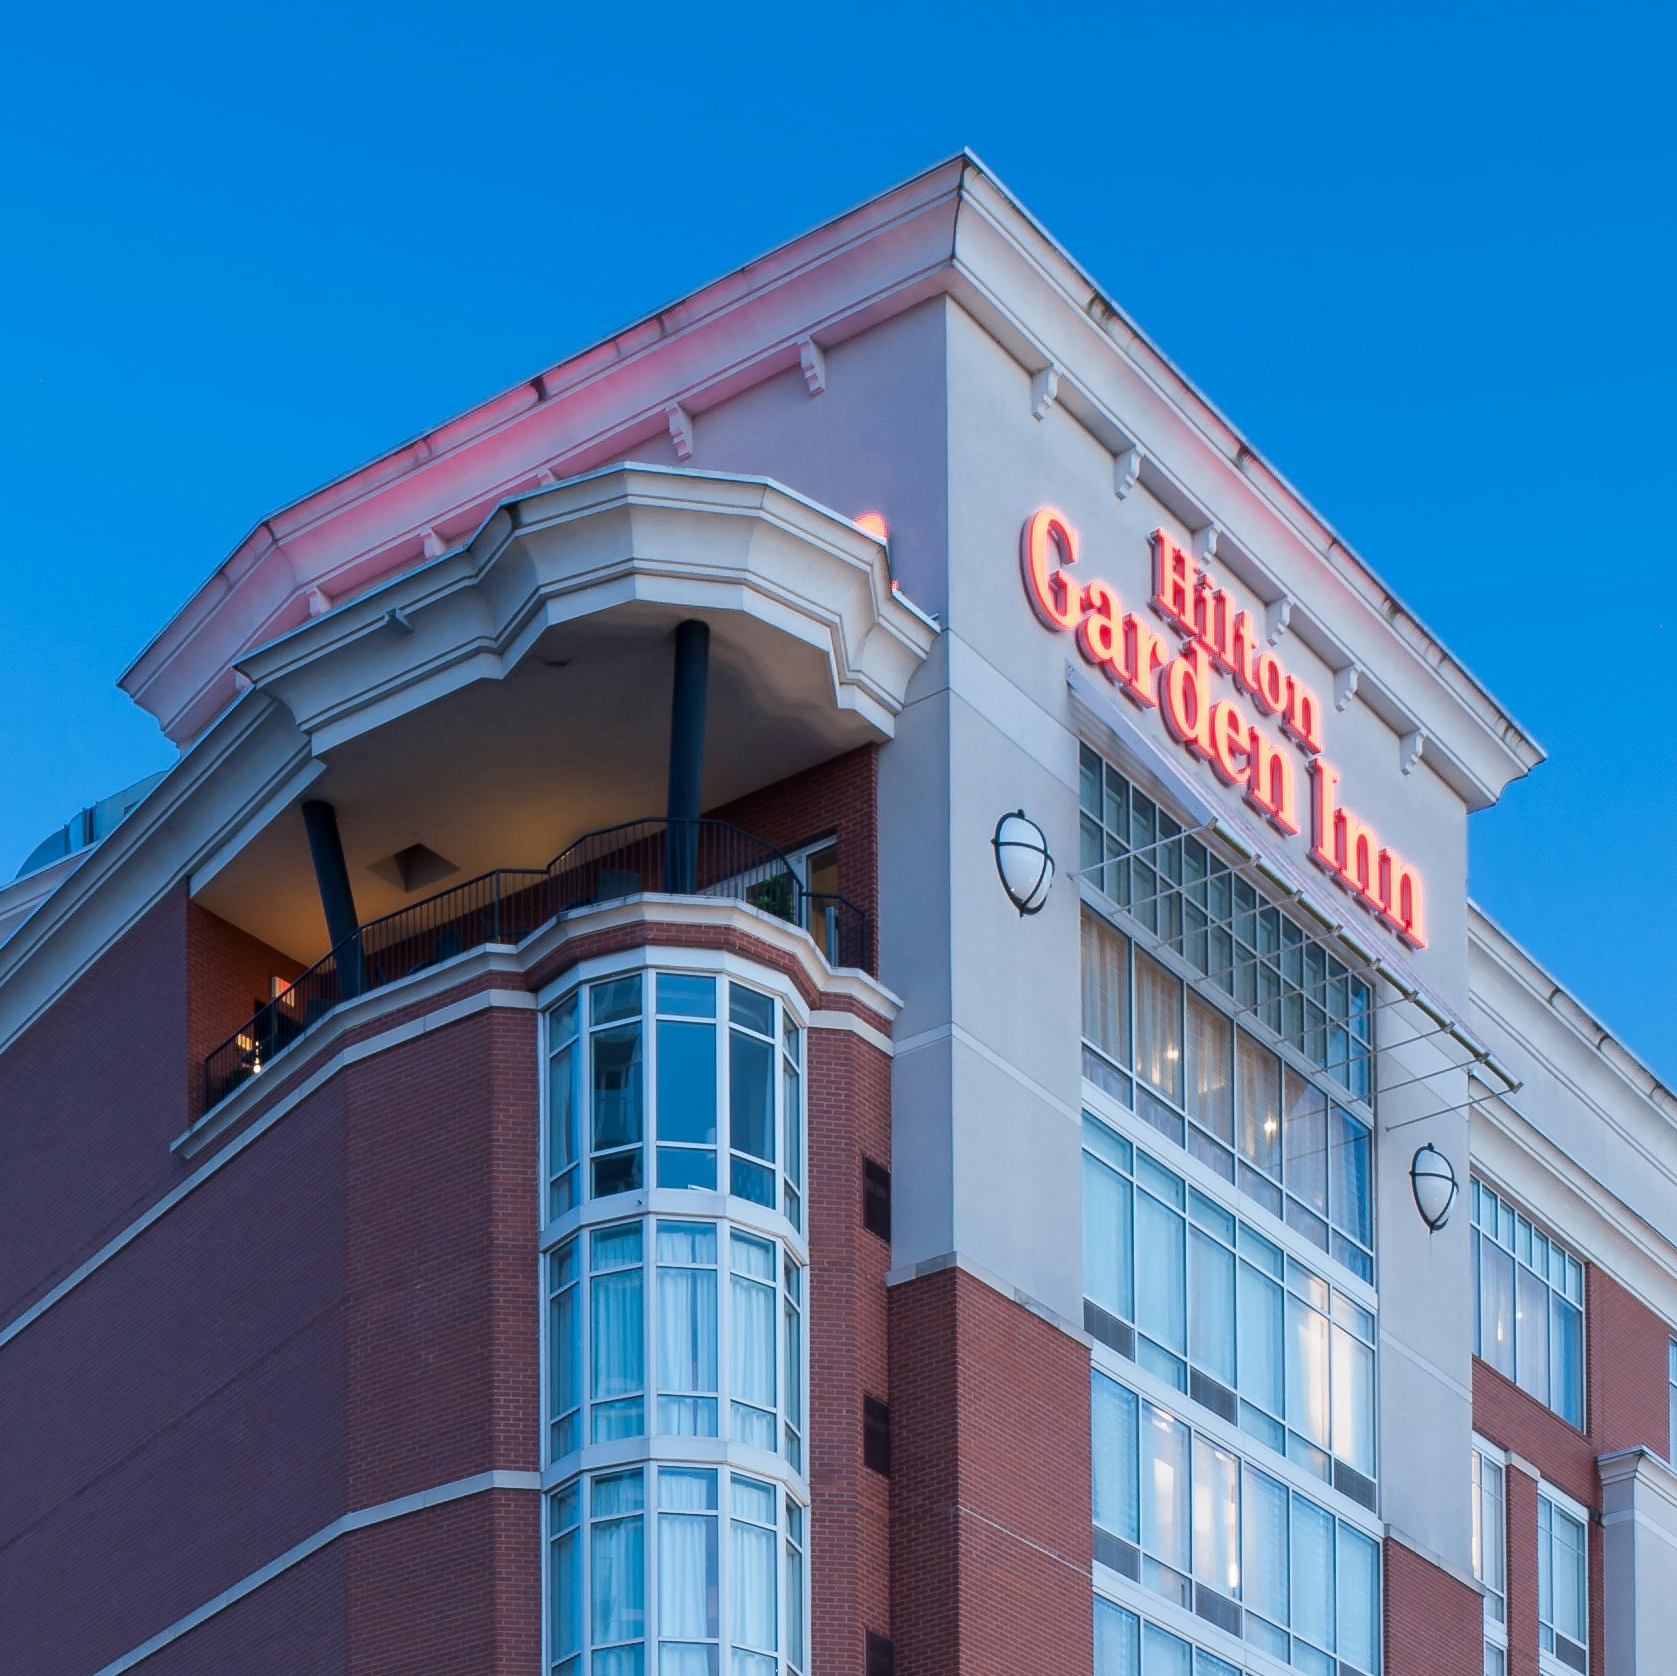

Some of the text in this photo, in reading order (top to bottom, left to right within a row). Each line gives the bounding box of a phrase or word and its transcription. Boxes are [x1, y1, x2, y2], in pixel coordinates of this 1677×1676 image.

[1021, 506, 1428, 949] Garden Inn
[1149, 527, 1323, 756] Hilton
